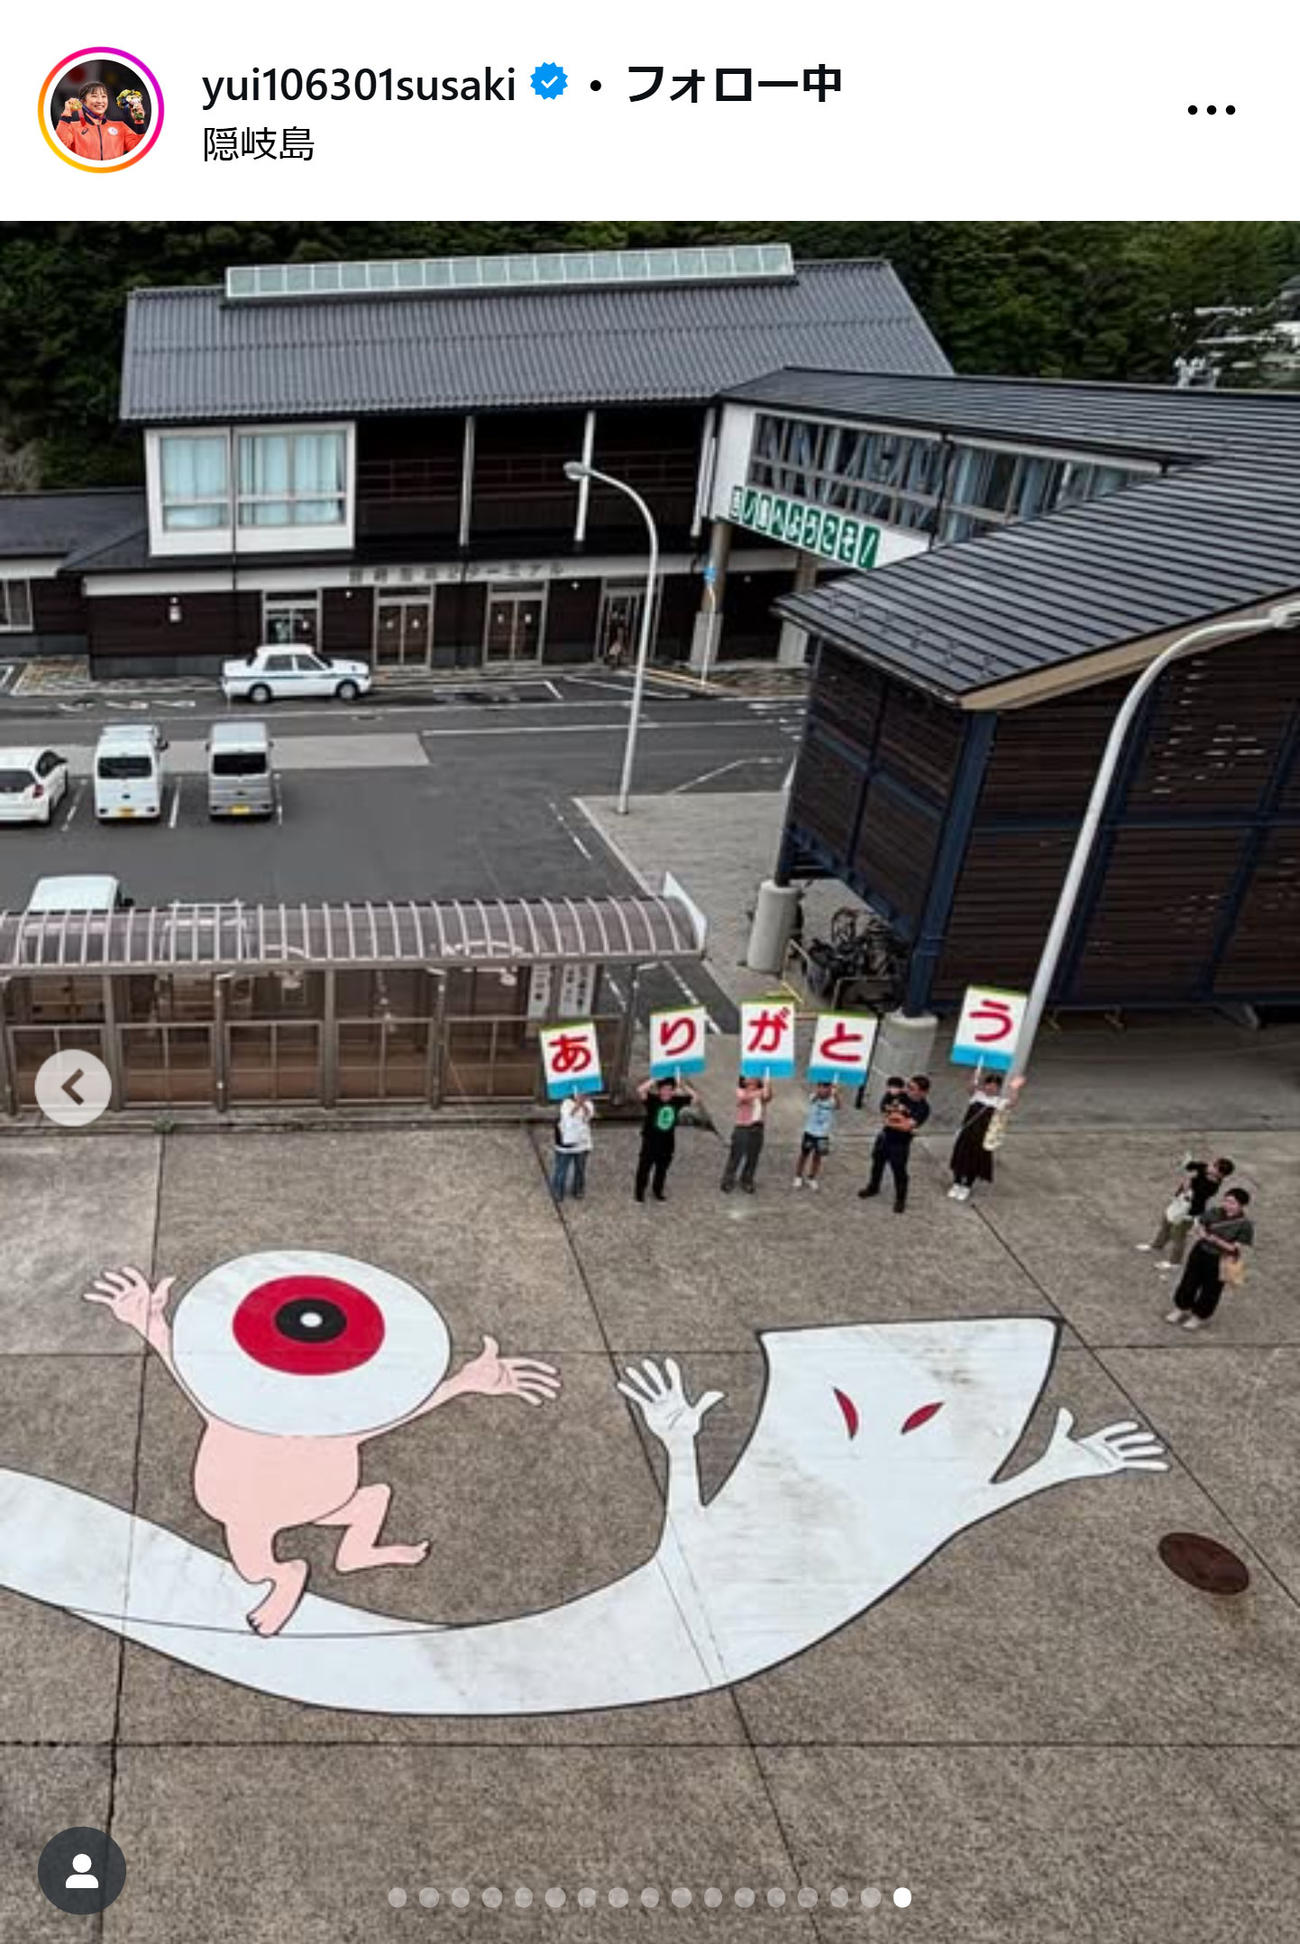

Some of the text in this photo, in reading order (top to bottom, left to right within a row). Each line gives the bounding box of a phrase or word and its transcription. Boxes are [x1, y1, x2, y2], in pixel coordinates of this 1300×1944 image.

[548, 1000, 1014, 1074] あ り が と う
